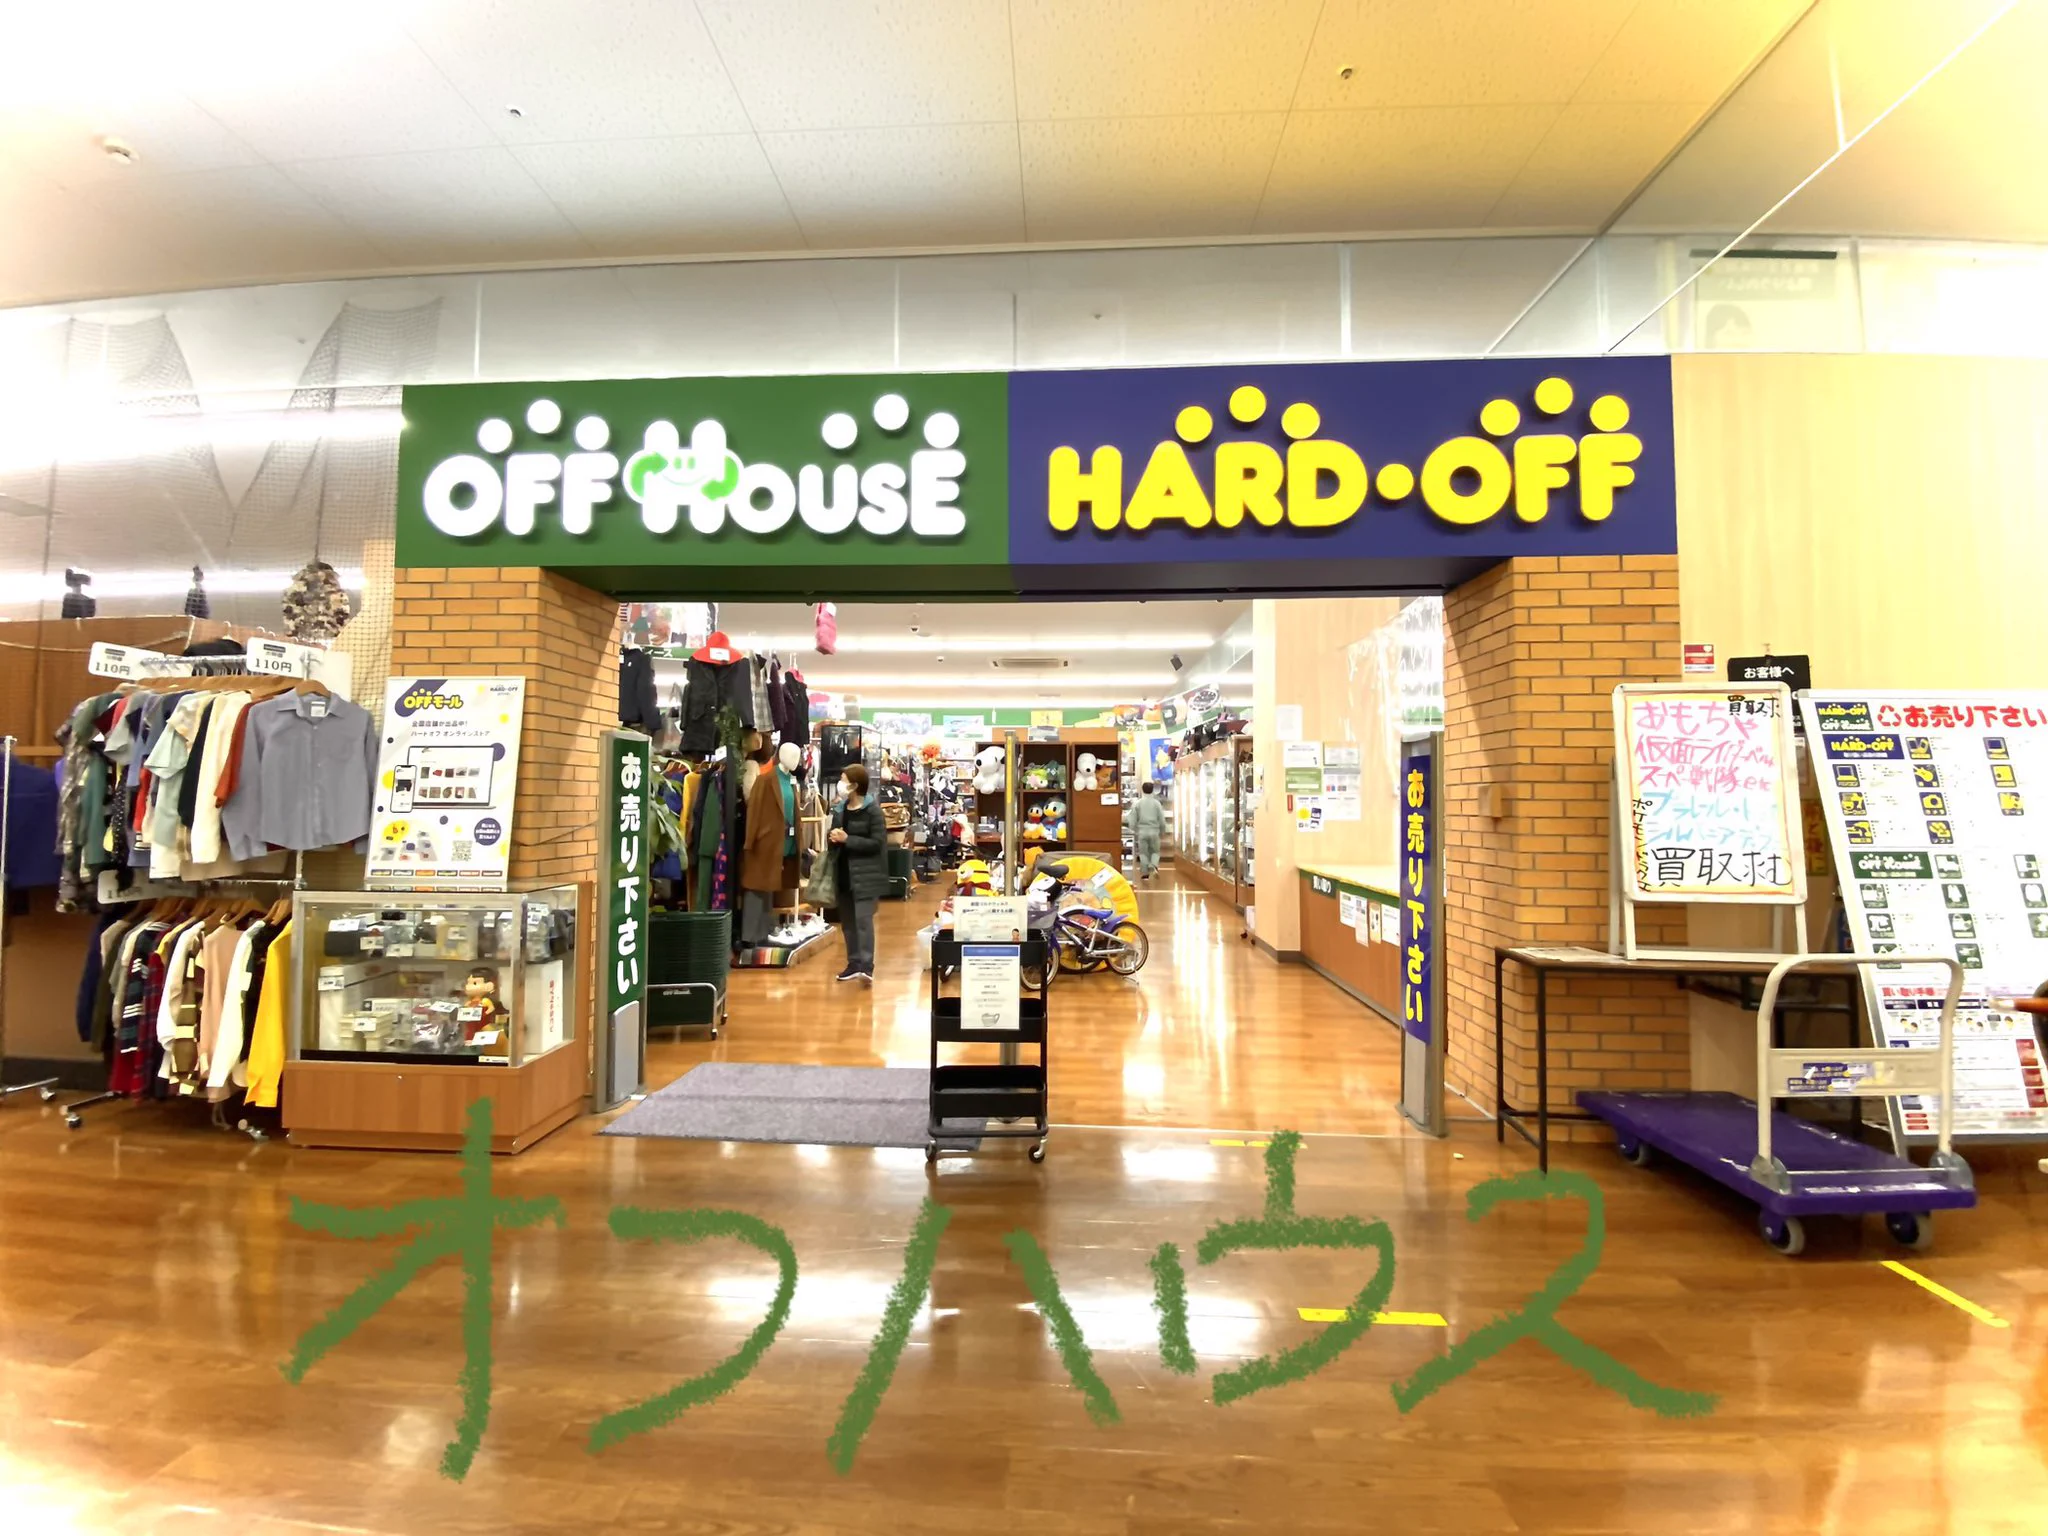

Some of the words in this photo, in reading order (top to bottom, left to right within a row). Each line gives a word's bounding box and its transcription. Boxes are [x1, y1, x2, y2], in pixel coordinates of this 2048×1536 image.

[423, 399, 619, 537] OFF
[622, 394, 966, 537] HOUSE
[95, 661, 131, 676] 110円
[255, 658, 293, 673] 110円
[1744, 666, 1795, 679] お客様へ
[1633, 701, 1759, 740] おもちゃ
[1903, 704, 2048, 729] お売り下さい
[616, 752, 642, 995] お売り下さい
[1651, 848, 1794, 887] 買取求む
[1405, 769, 1425, 1023] お売り下さい
